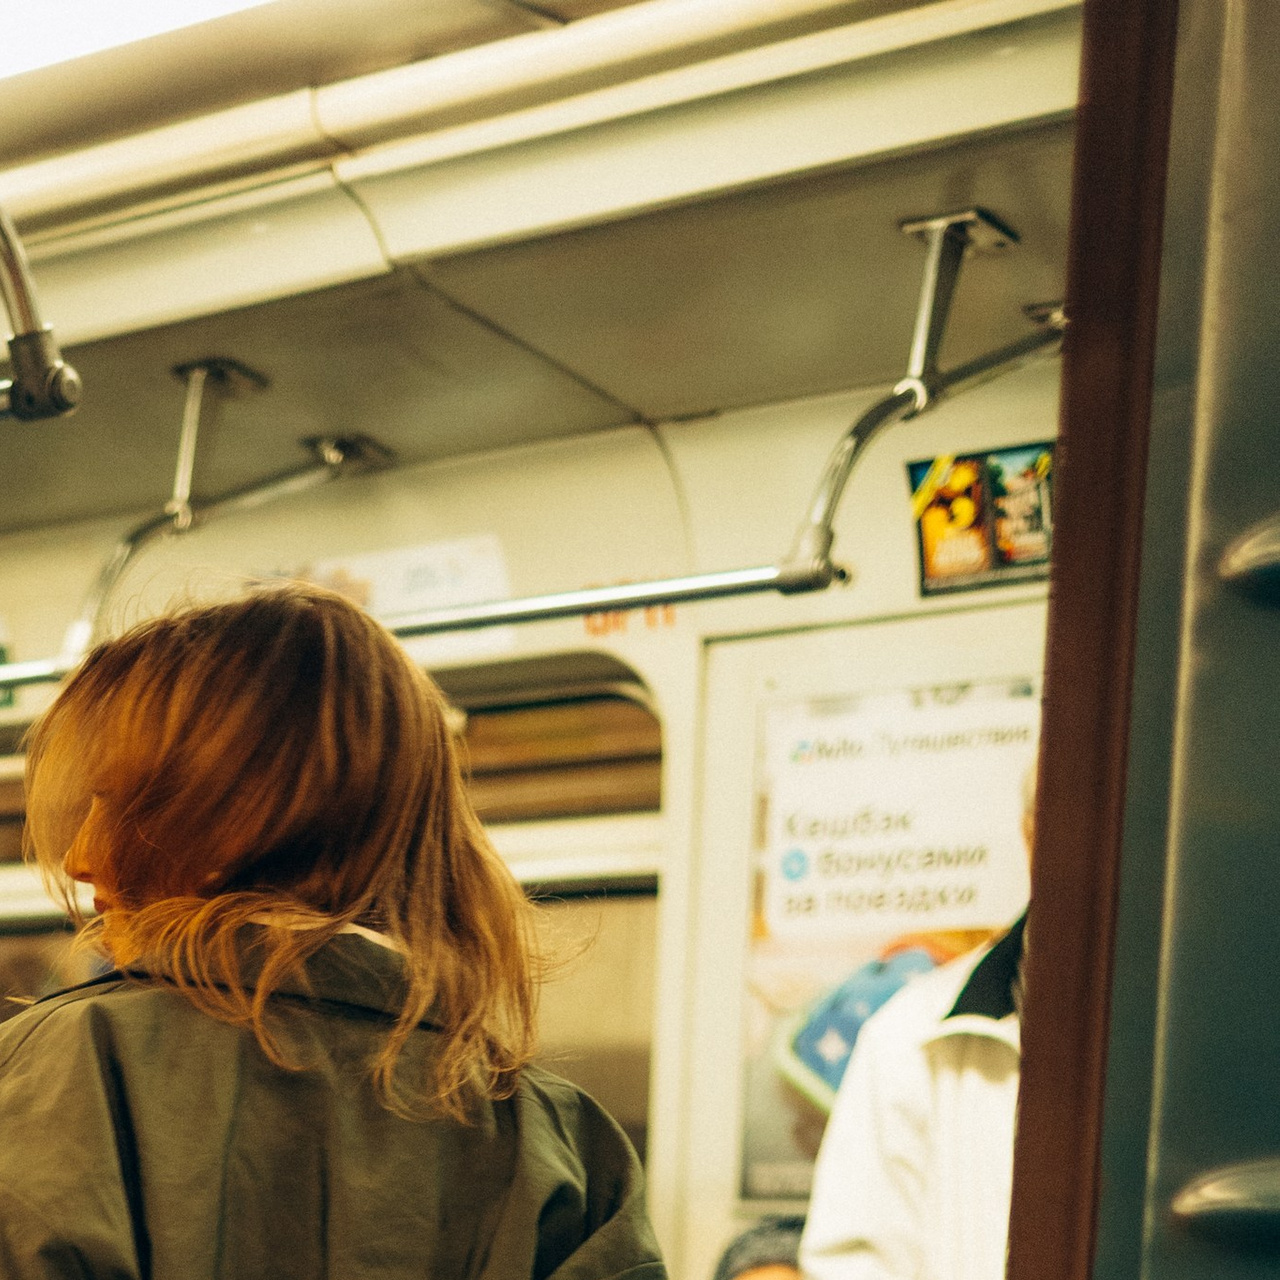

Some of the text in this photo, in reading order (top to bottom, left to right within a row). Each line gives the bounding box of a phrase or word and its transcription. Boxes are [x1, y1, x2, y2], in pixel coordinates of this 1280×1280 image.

[819, 846, 989, 879] бонусами
[784, 885, 978, 916] за поездки
